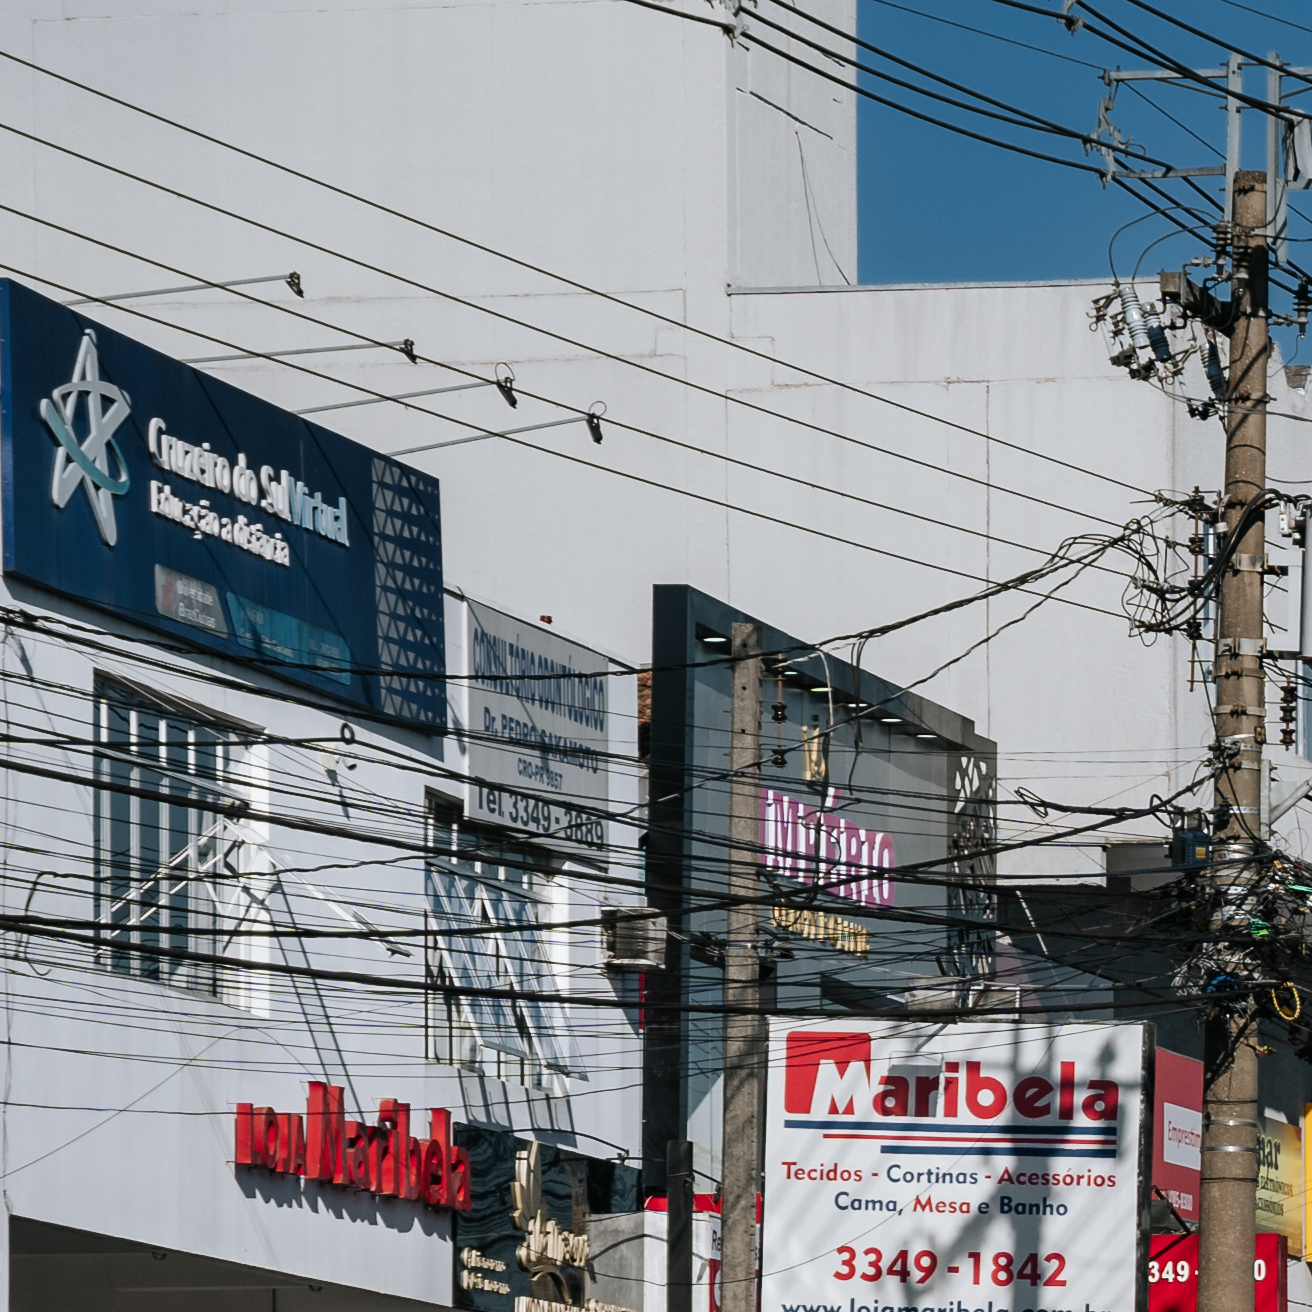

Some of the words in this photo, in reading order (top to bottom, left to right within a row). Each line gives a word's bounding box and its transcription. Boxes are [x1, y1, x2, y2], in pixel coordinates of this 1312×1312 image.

[149, 417, 231, 494] Cruzeiro
[232, 452, 259, 506] do
[151, 480, 220, 540] Educação
[221, 517, 233, 543] a
[483, 706, 498, 737] Dr.
[502, 713, 538, 752] PEDRO
[544, 767, 563, 792] 9857
[810, 1058, 1120, 1122] Maribela
[235, 1101, 305, 1176] Loja
[304, 1081, 473, 1212] Maribela
[781, 1160, 864, 1183] Tecidos
[885, 1164, 979, 1186] Cortinas
[996, 1166, 1117, 1188] Acessórios
[833, 1190, 904, 1216] Cama,
[912, 1194, 971, 1215] Mesa
[977, 1201, 990, 1215] e
[999, 1195, 1069, 1217] Banho
